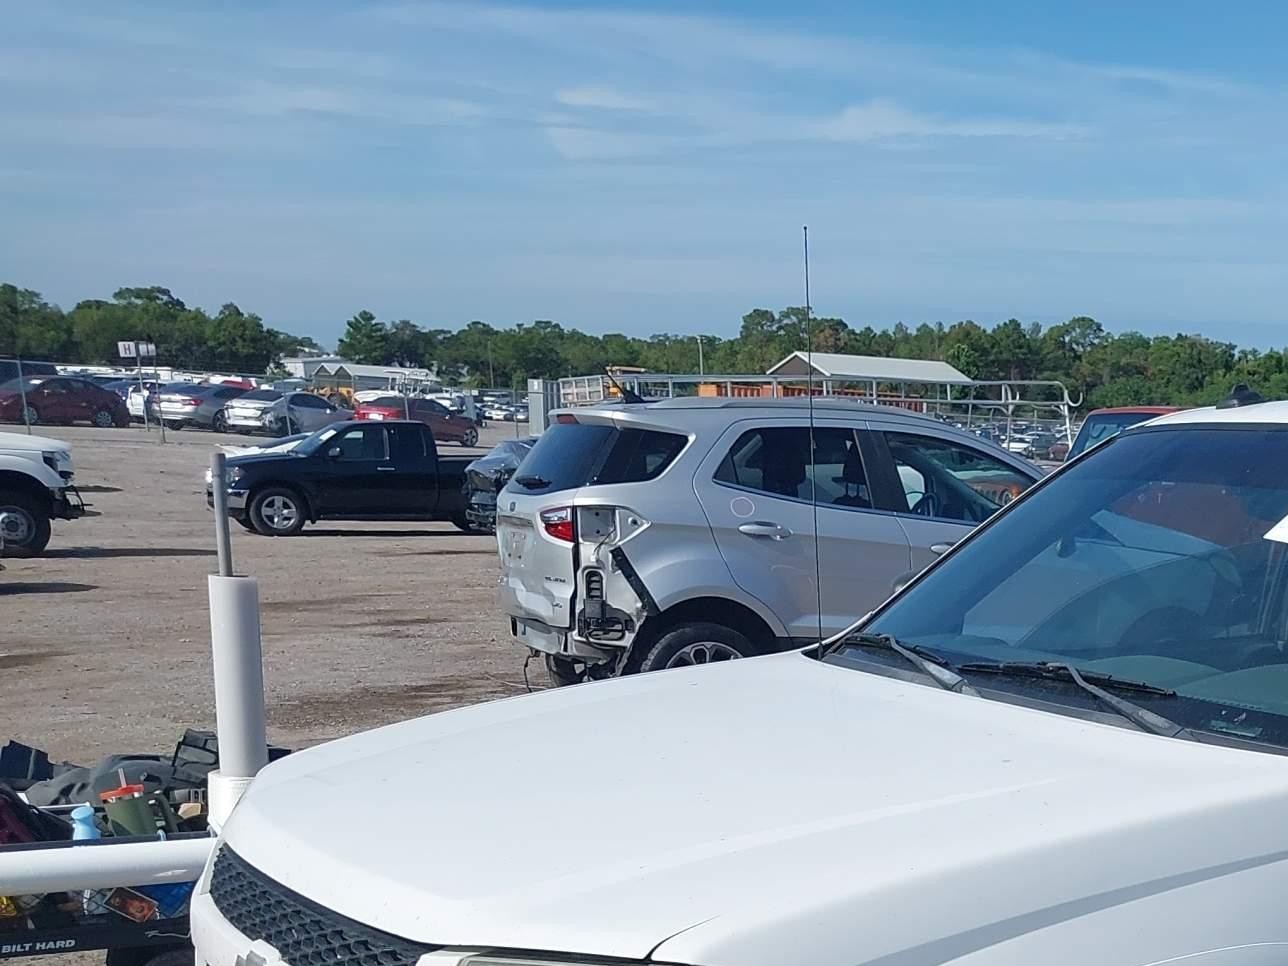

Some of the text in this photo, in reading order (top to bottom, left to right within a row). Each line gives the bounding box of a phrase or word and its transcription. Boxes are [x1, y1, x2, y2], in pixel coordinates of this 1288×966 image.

[122, 343, 132, 356] H
[1, 939, 76, 954] BILT HARD
